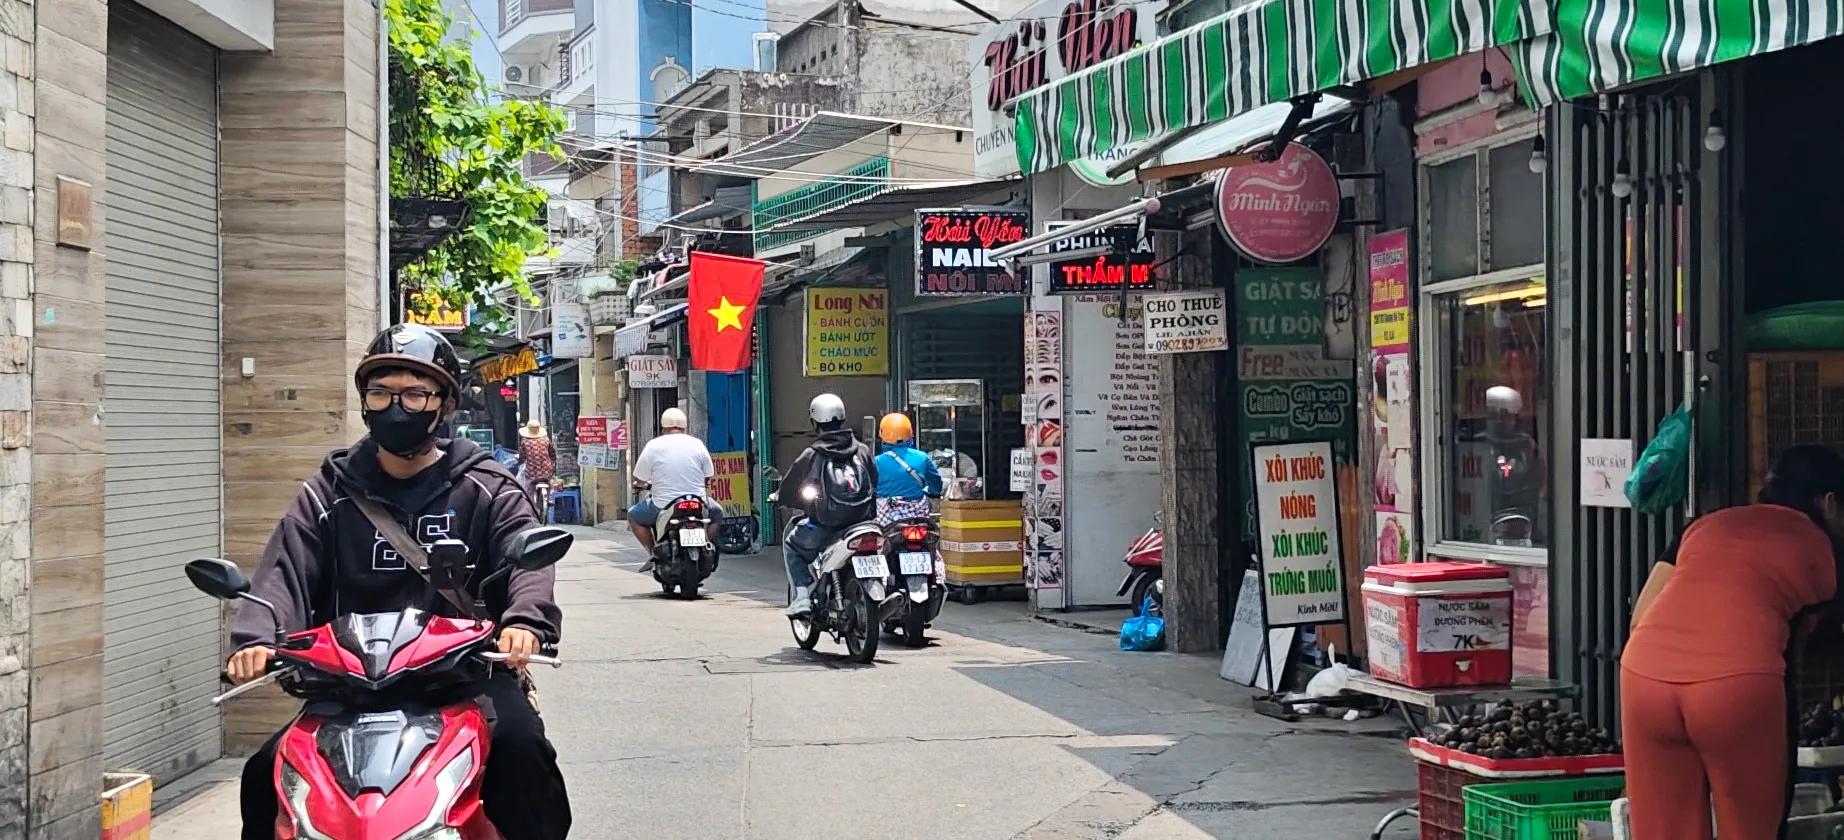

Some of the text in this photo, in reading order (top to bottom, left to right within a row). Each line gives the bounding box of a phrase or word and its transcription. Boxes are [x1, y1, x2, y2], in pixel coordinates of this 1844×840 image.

[815, 293, 853, 314] Long
[1147, 299, 1176, 313] CHO
[1150, 314, 1219, 329] PHÒNG
[839, 362, 863, 372] KHO
[1249, 390, 1288, 412] Combo
[1265, 451, 1325, 482] XÔI KHÚC
[1279, 490, 1316, 520] NÓNG
[1272, 526, 1328, 558] XÔI KHÚC
[1452, 634, 1474, 649] 7K
